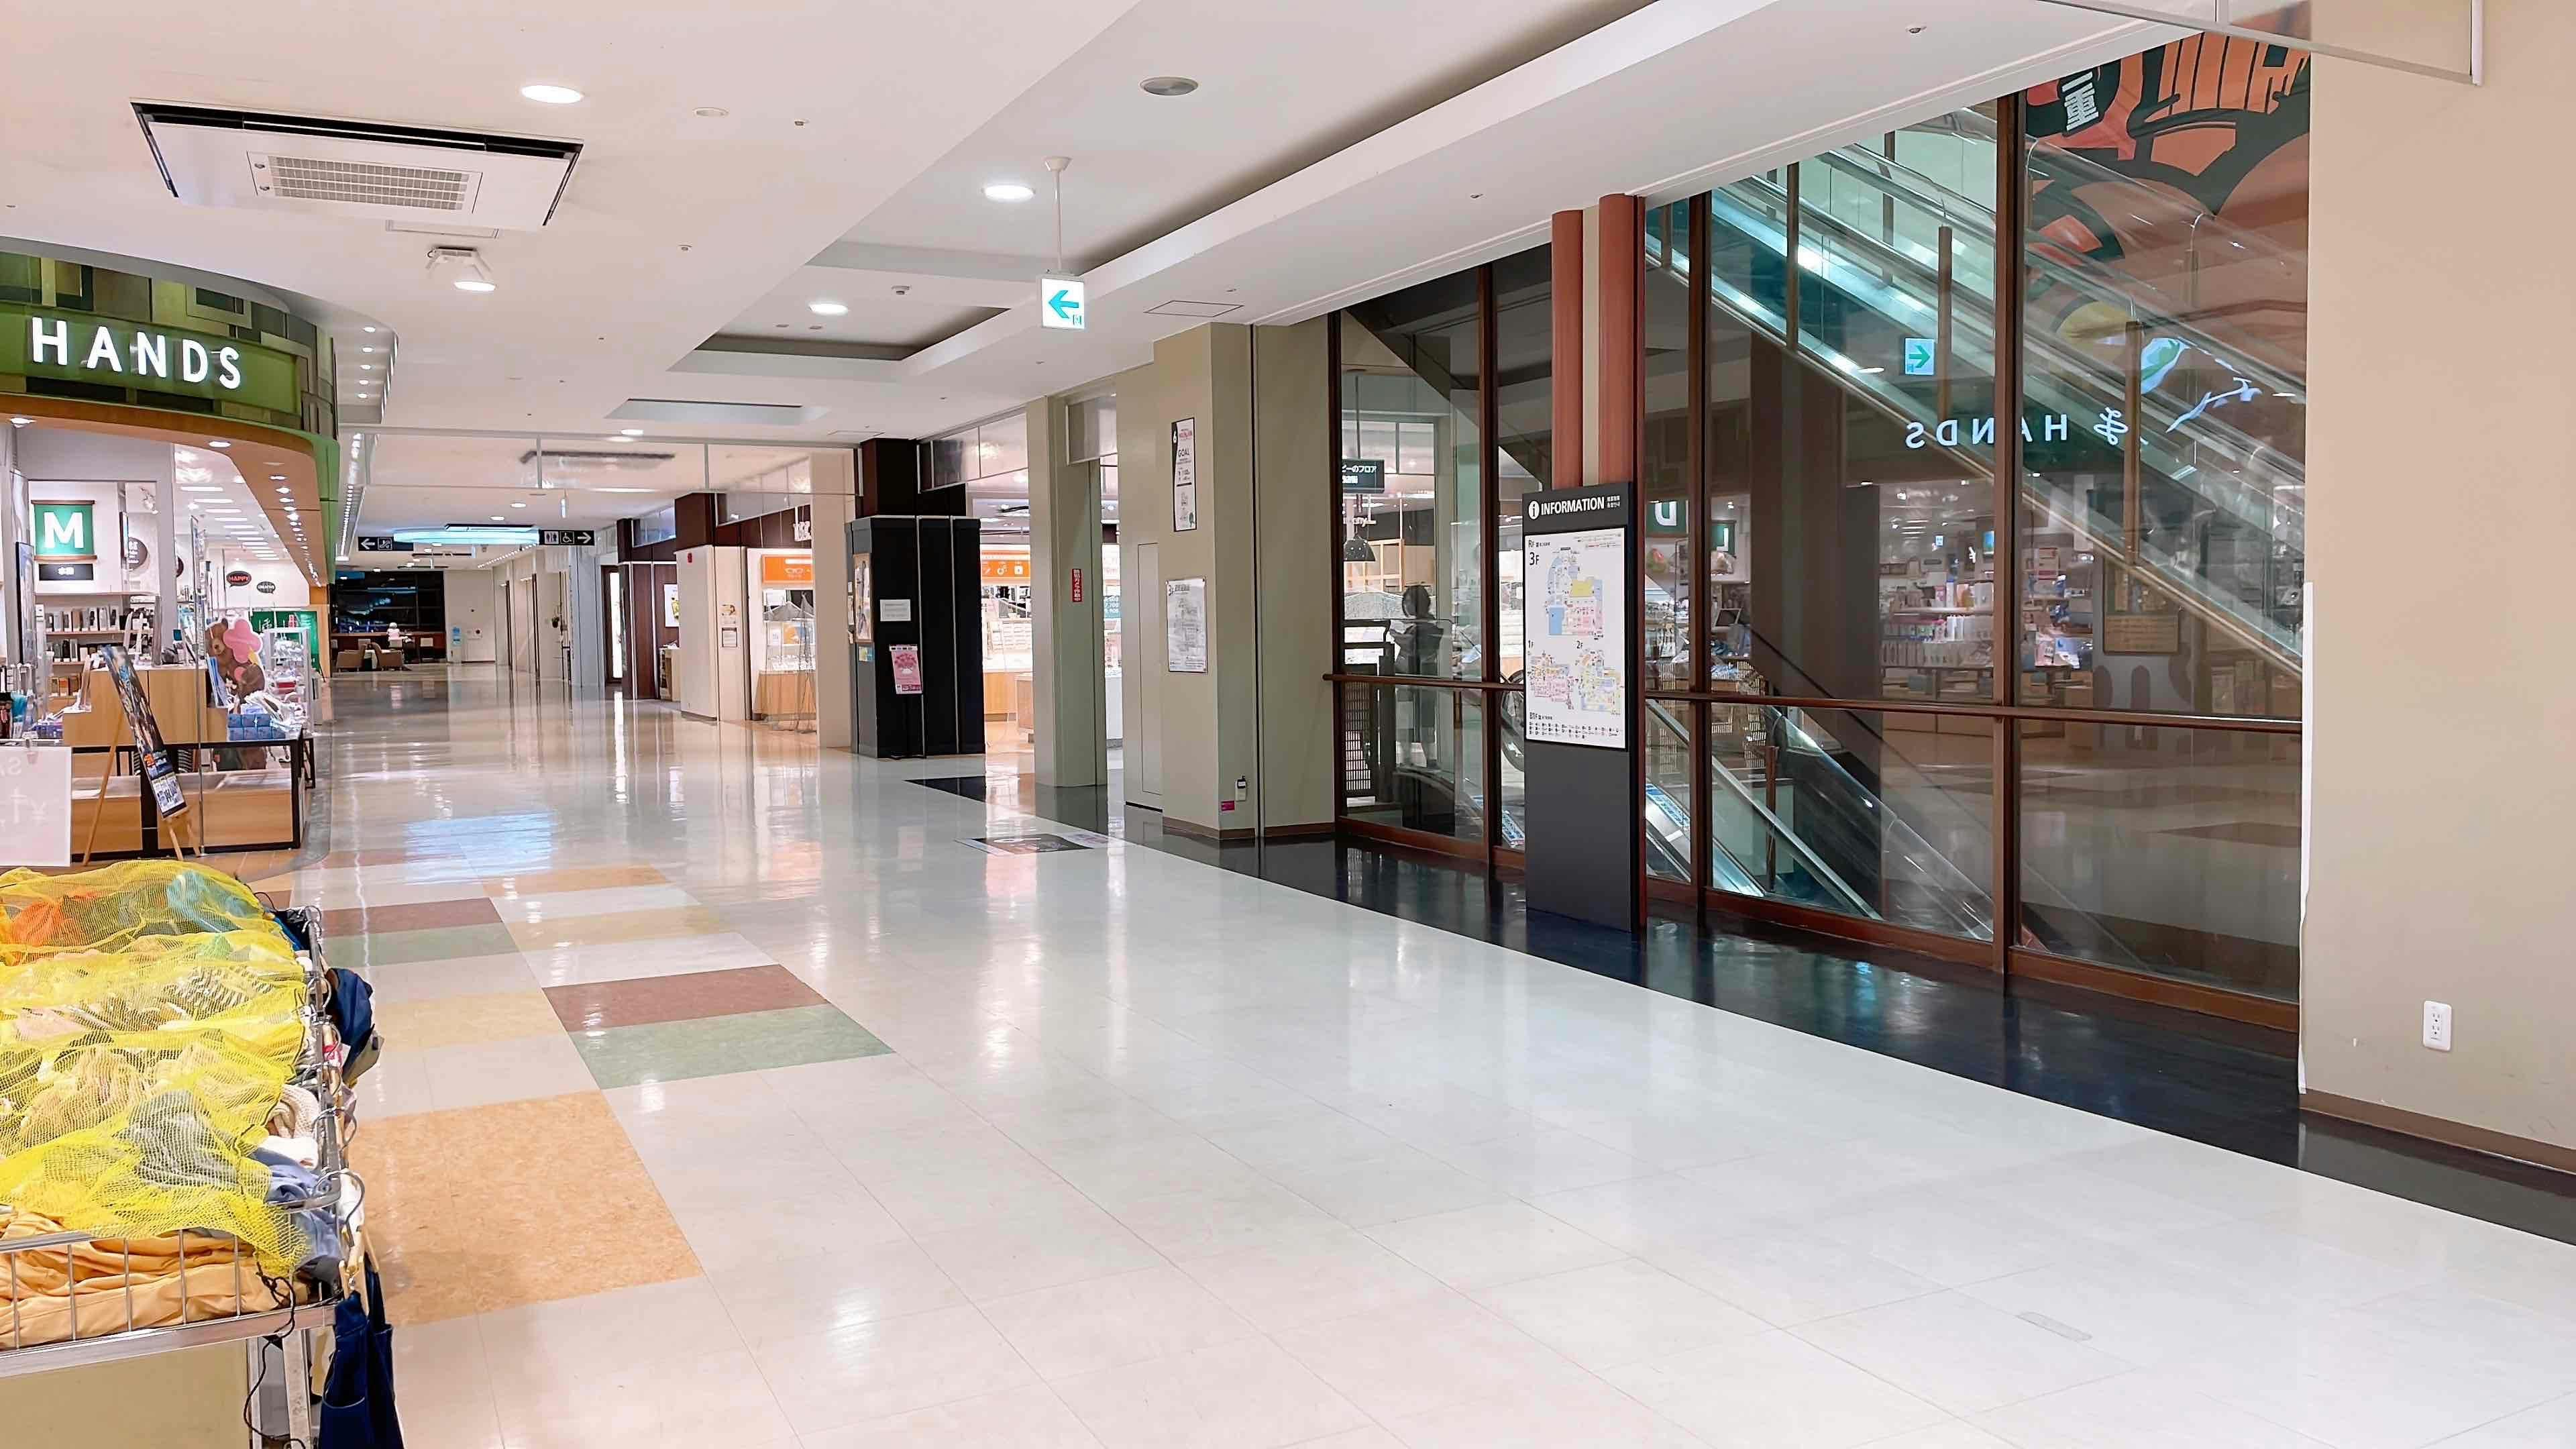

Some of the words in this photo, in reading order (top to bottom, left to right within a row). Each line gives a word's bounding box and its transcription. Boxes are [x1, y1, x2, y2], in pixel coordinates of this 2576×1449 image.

[32, 317, 241, 389] HANDS
[1178, 447, 1190, 458] GOAL
[1541, 496, 1605, 516] INFORMATION
[44, 511, 84, 549] M
[1529, 551, 1540, 566] 3F
